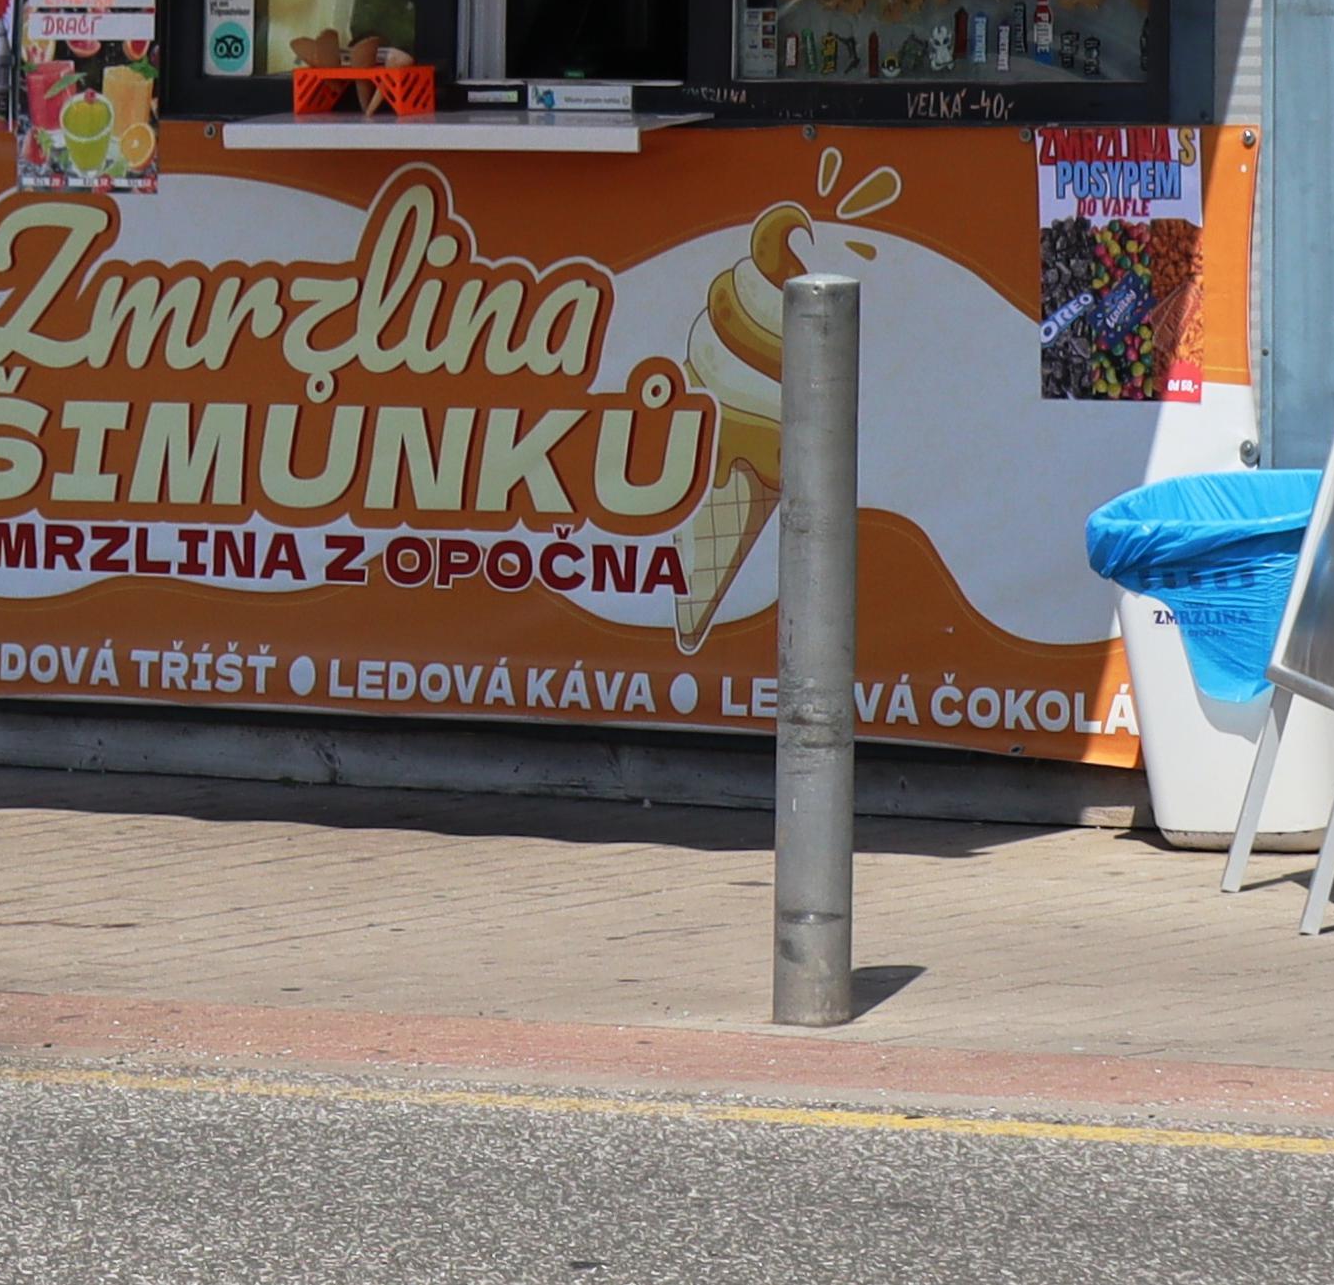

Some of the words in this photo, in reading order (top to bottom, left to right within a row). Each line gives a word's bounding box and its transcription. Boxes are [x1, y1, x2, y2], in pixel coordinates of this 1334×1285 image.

[906, 89, 968, 116] VELKÁ
[1039, 127, 1172, 165] ZMRZLINA
[1178, 127, 1196, 165] S
[1056, 160, 1182, 200] POSYPEM
[1077, 198, 1097, 217] DO
[1102, 198, 1151, 217] VAFLE
[1040, 293, 1094, 344] OREO
[324, 535, 369, 586] Z
[384, 524, 690, 597] OPOČNA
[130, 640, 276, 695] TŘÍŠŤ
[326, 654, 515, 708] LEDOVÁ
[523, 655, 656, 713] KÁVA
[721, 673, 920, 725] LEVÁ
